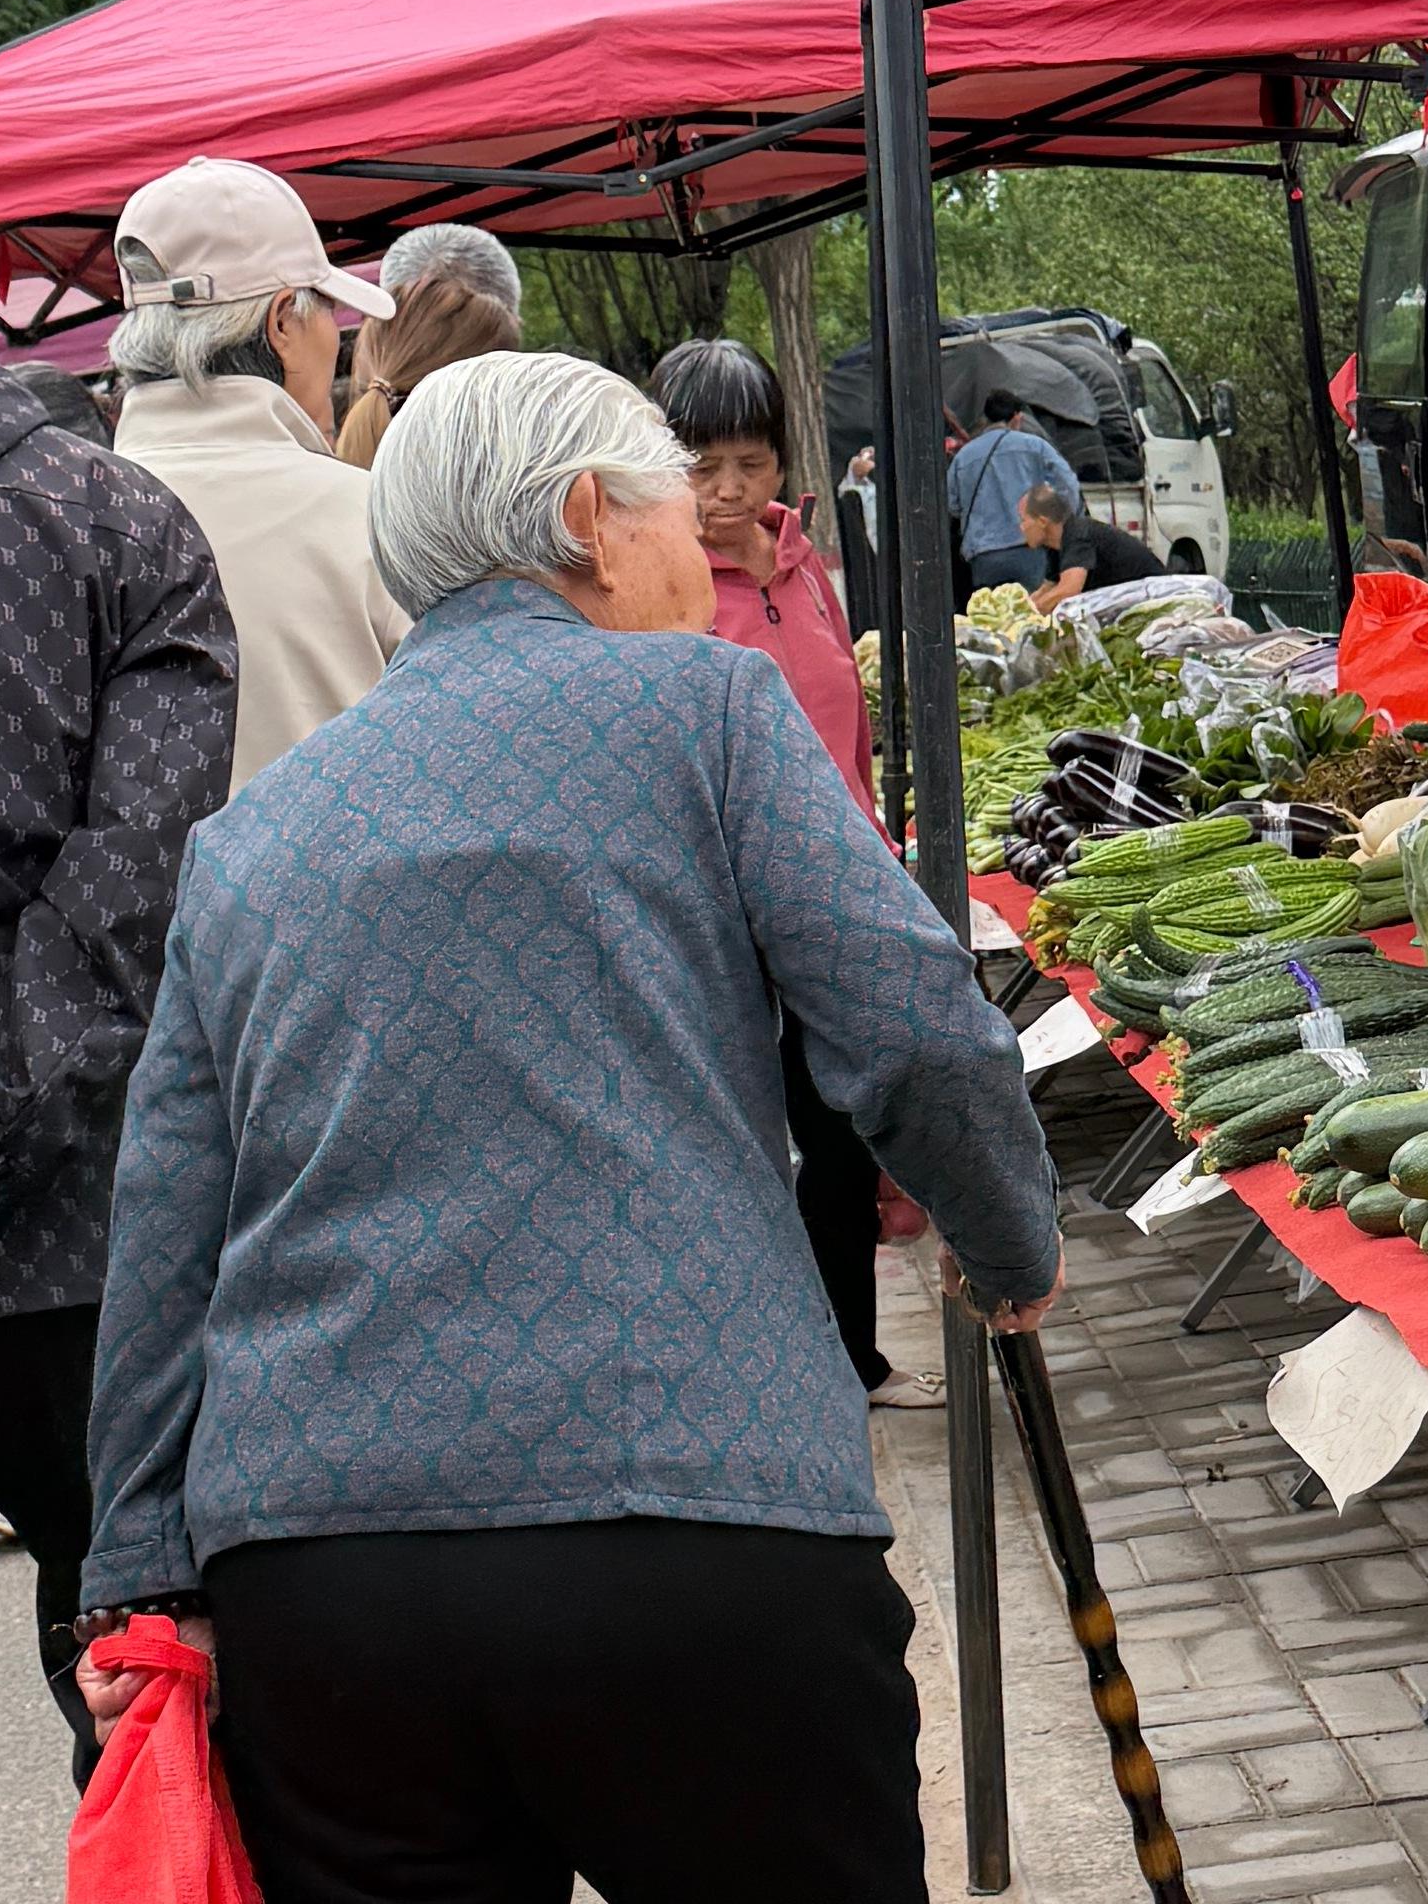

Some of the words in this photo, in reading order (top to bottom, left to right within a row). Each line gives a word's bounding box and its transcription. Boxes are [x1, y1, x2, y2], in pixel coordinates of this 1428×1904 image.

[50, 554, 64, 572] B
[26, 578, 42, 595] B
[50, 610, 64, 627] B
[33, 743, 48, 762] B
